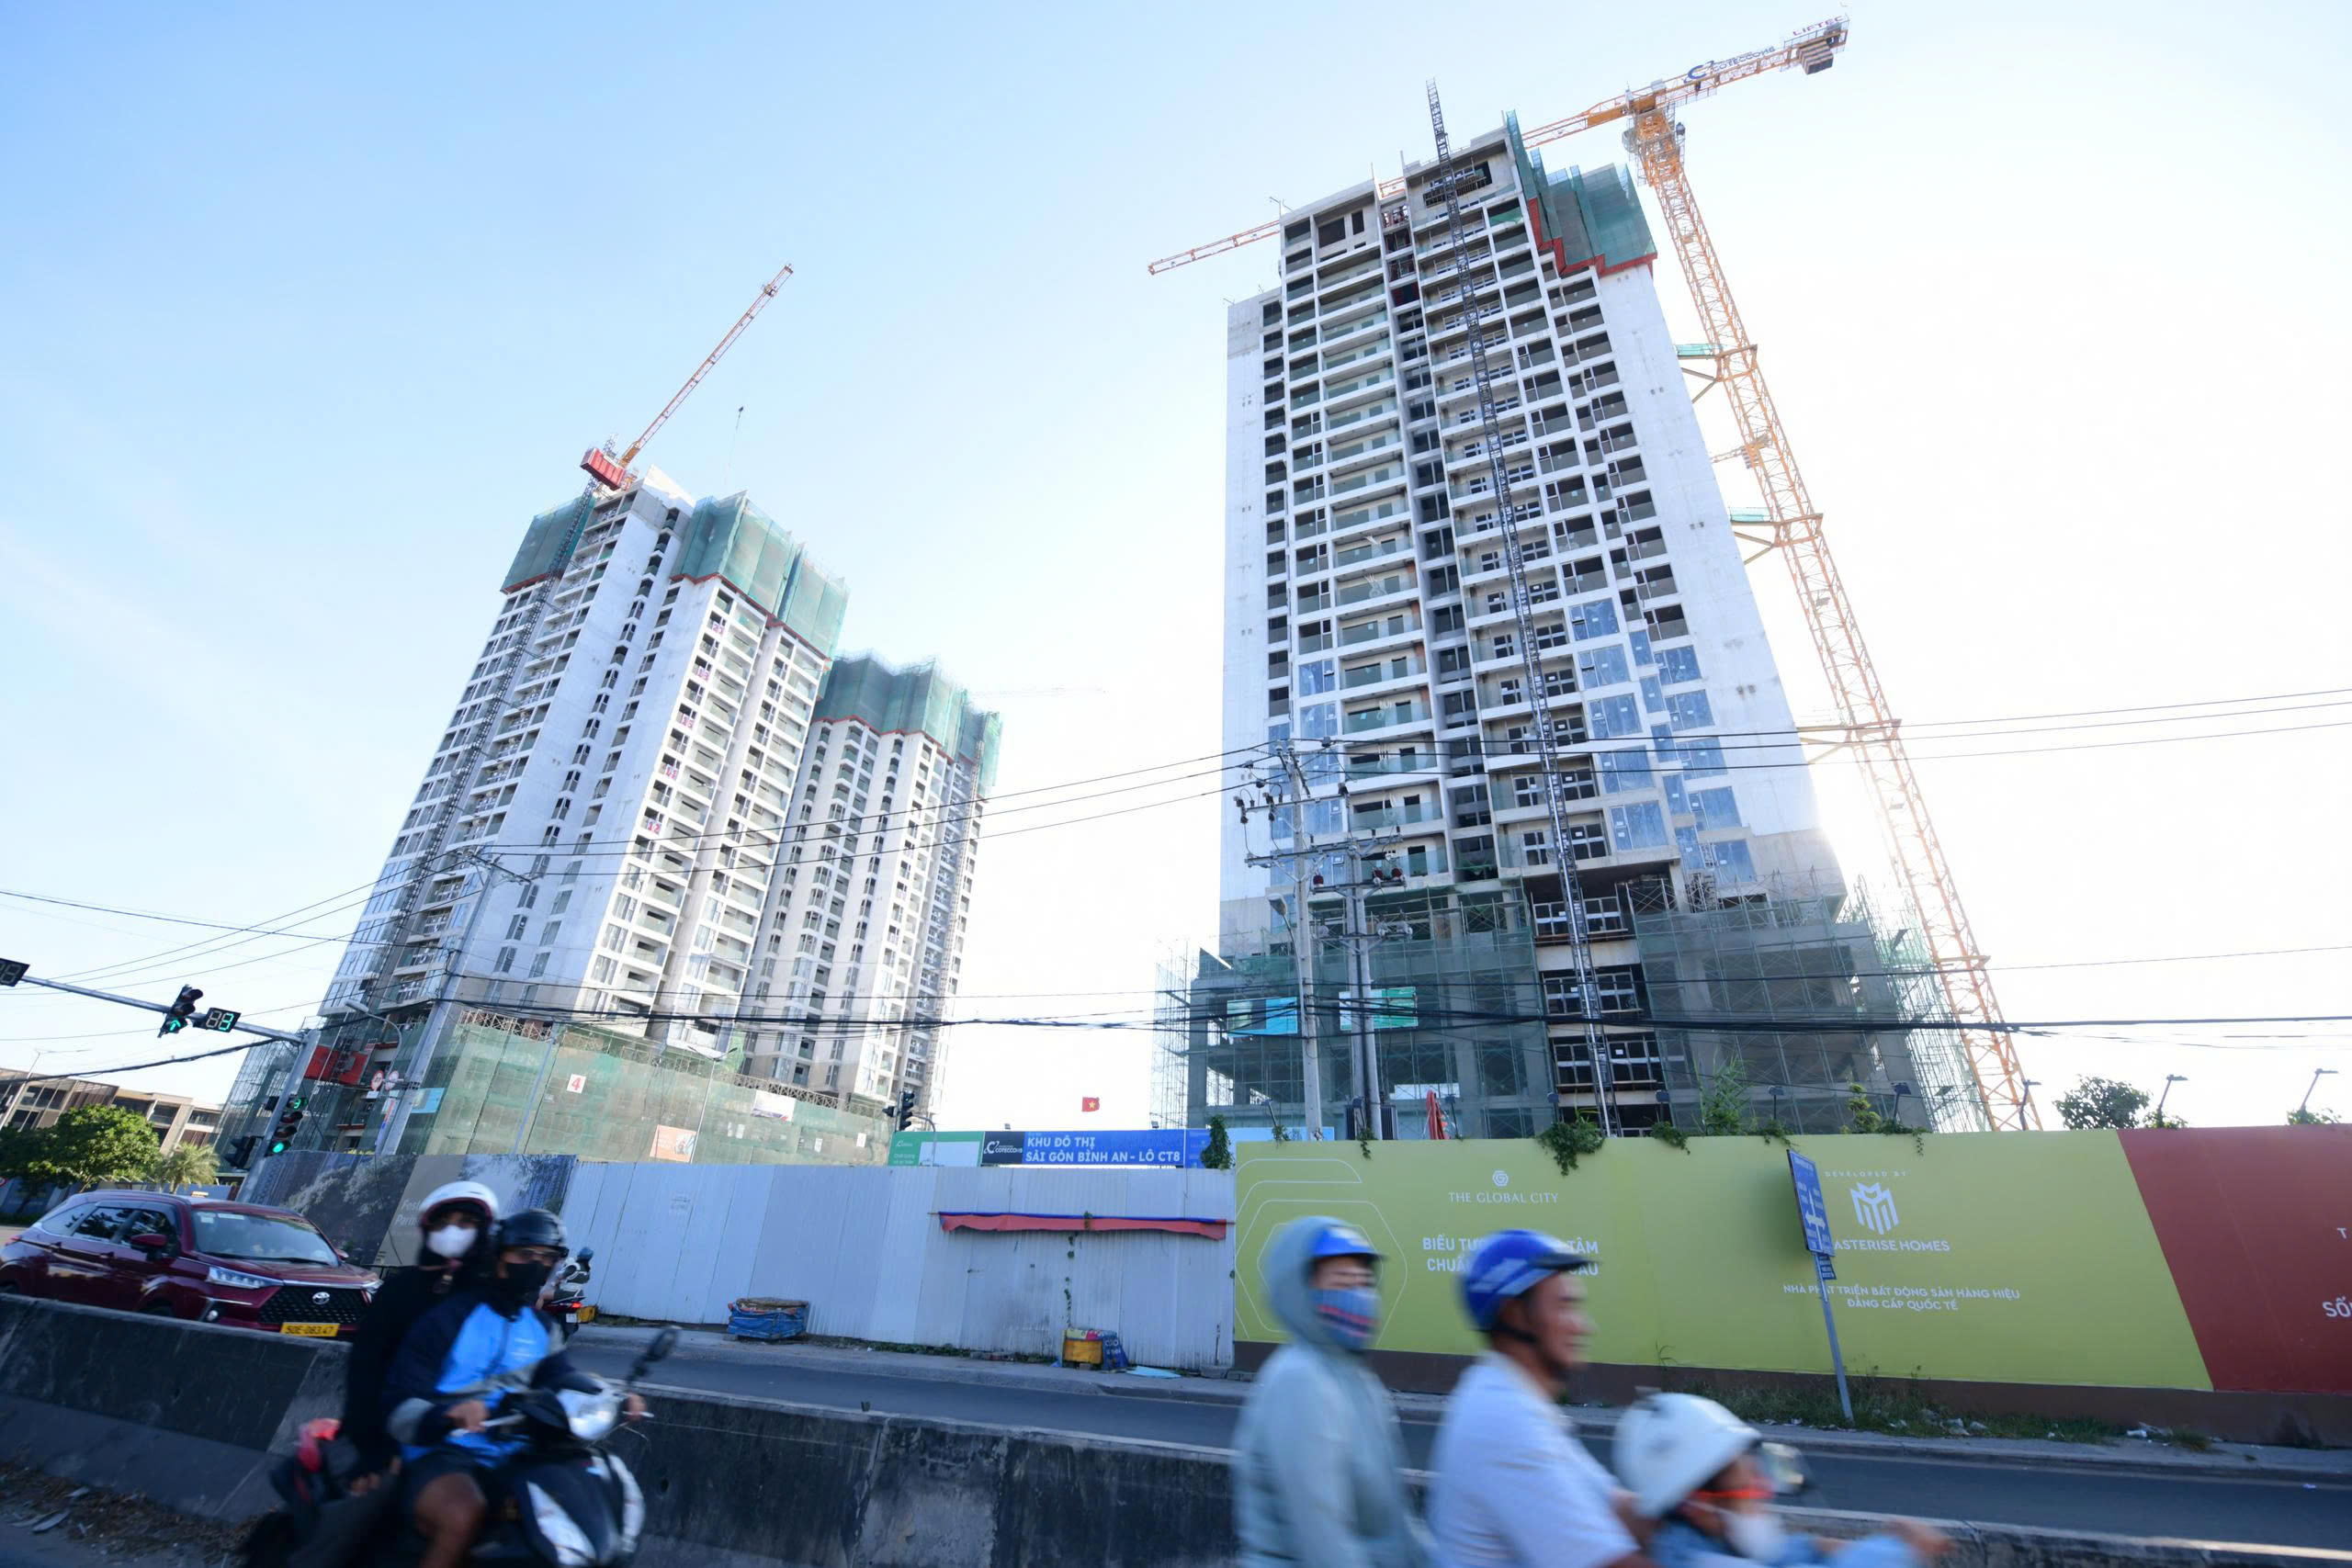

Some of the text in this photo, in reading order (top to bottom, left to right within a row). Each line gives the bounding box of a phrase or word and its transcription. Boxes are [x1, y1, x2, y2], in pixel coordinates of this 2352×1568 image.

[571, 1077, 582, 1091] 4
[1027, 1136, 1095, 1150] KHU ĐÔ THỊ
[1025, 1150, 1046, 1162] SÀI
[1048, 1150, 1074, 1162] GÒN
[1078, 1150, 1108, 1162] BÌNH
[1112, 1152, 1127, 1162] AN
[1138, 1149, 1154, 1161] LÔ
[1158, 1152, 1182, 1161] CT8
[1448, 1192, 1559, 1204] THE GLOBAL CITY
[1833, 1239, 1898, 1251] ASTERISE
[1900, 1240, 1951, 1251] HOMES
[1784, 1283, 1806, 1294] NHÀ
[1894, 1285, 1928, 1300] ĐỘNG
[1955, 1286, 1990, 1299] HÀNG
[1992, 1286, 2020, 1302] HIỆU
